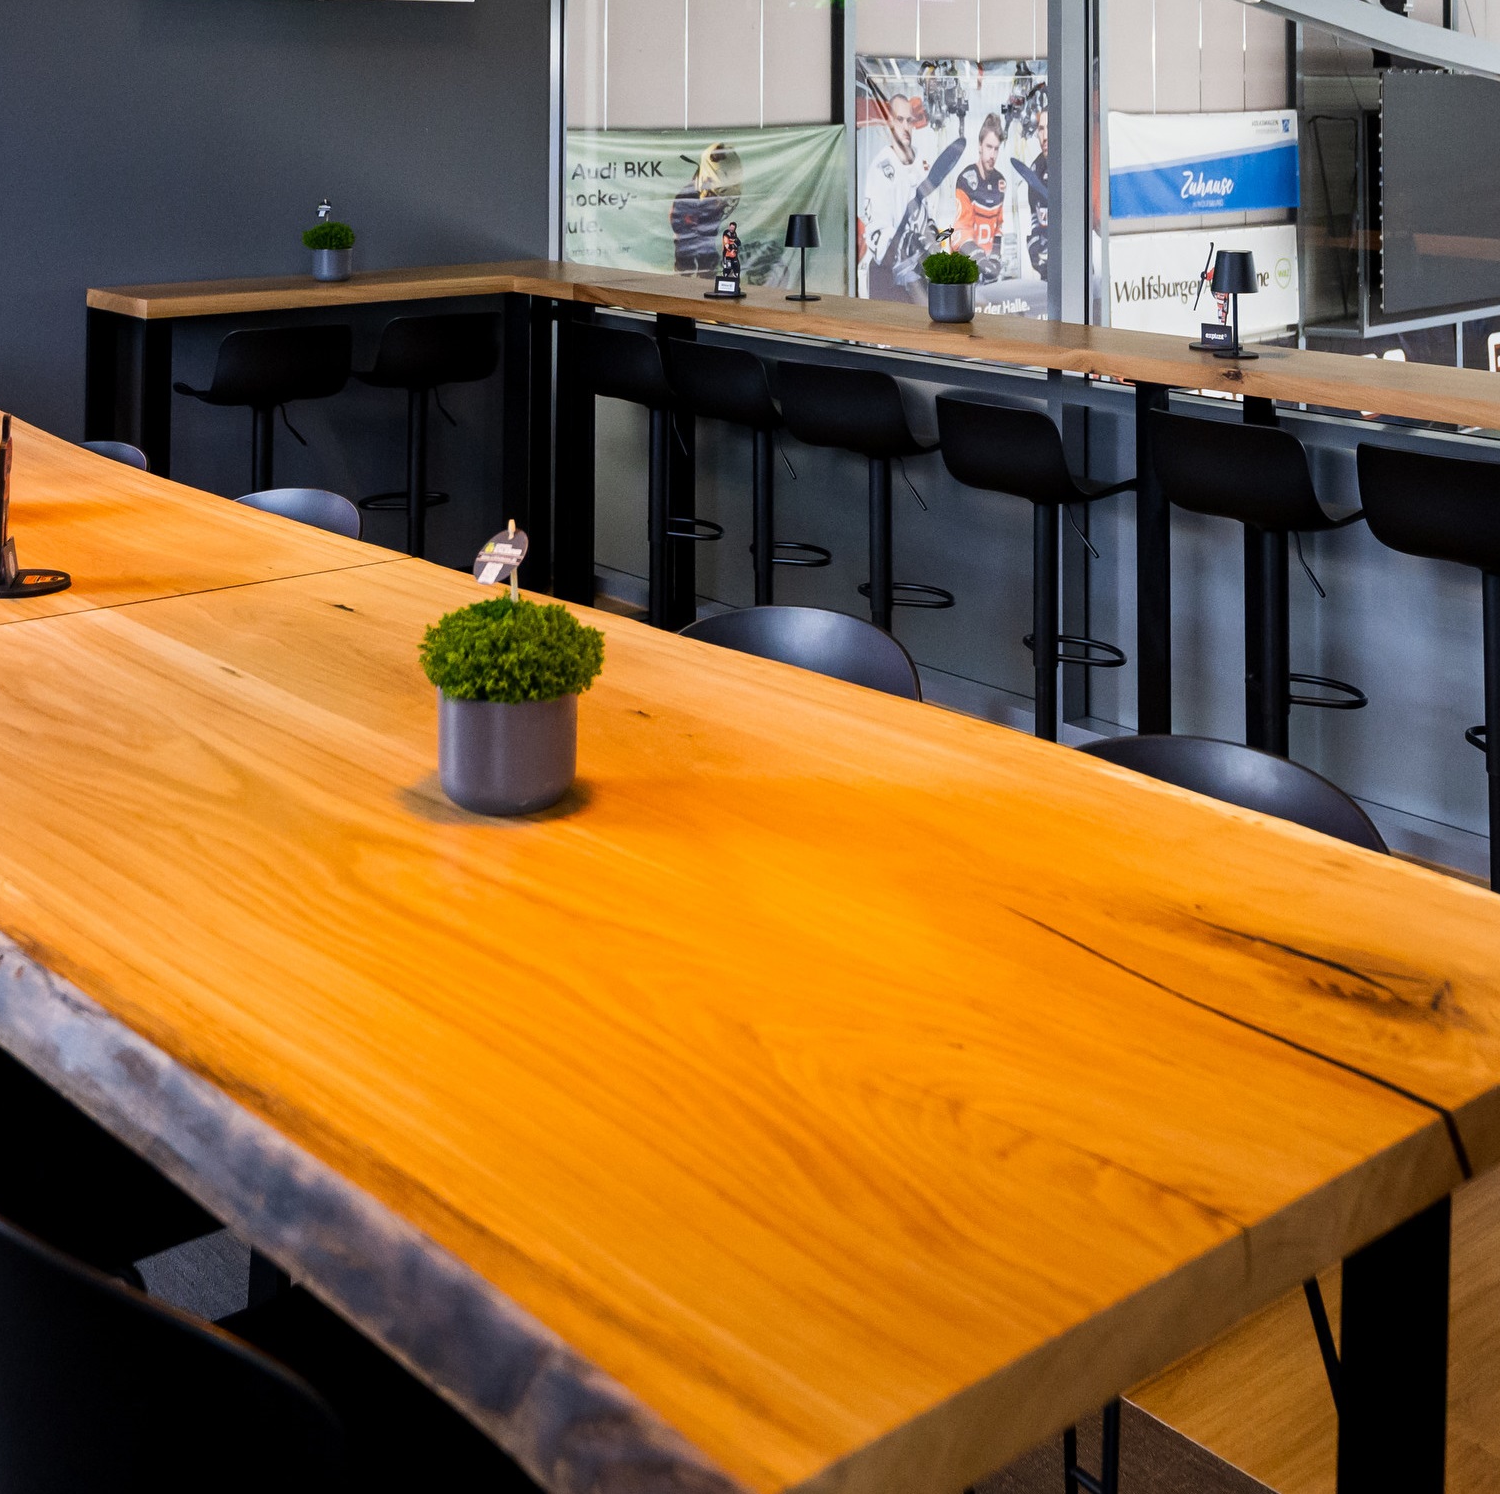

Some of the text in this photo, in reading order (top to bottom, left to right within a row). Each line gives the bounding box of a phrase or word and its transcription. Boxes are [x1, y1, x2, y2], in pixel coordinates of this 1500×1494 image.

[571, 161, 664, 180] Audi BKK
[1181, 171, 1234, 199] Zuhause
[1115, 274, 1201, 304] Wolfsburger
[1003, 298, 1030, 314] Halle.
